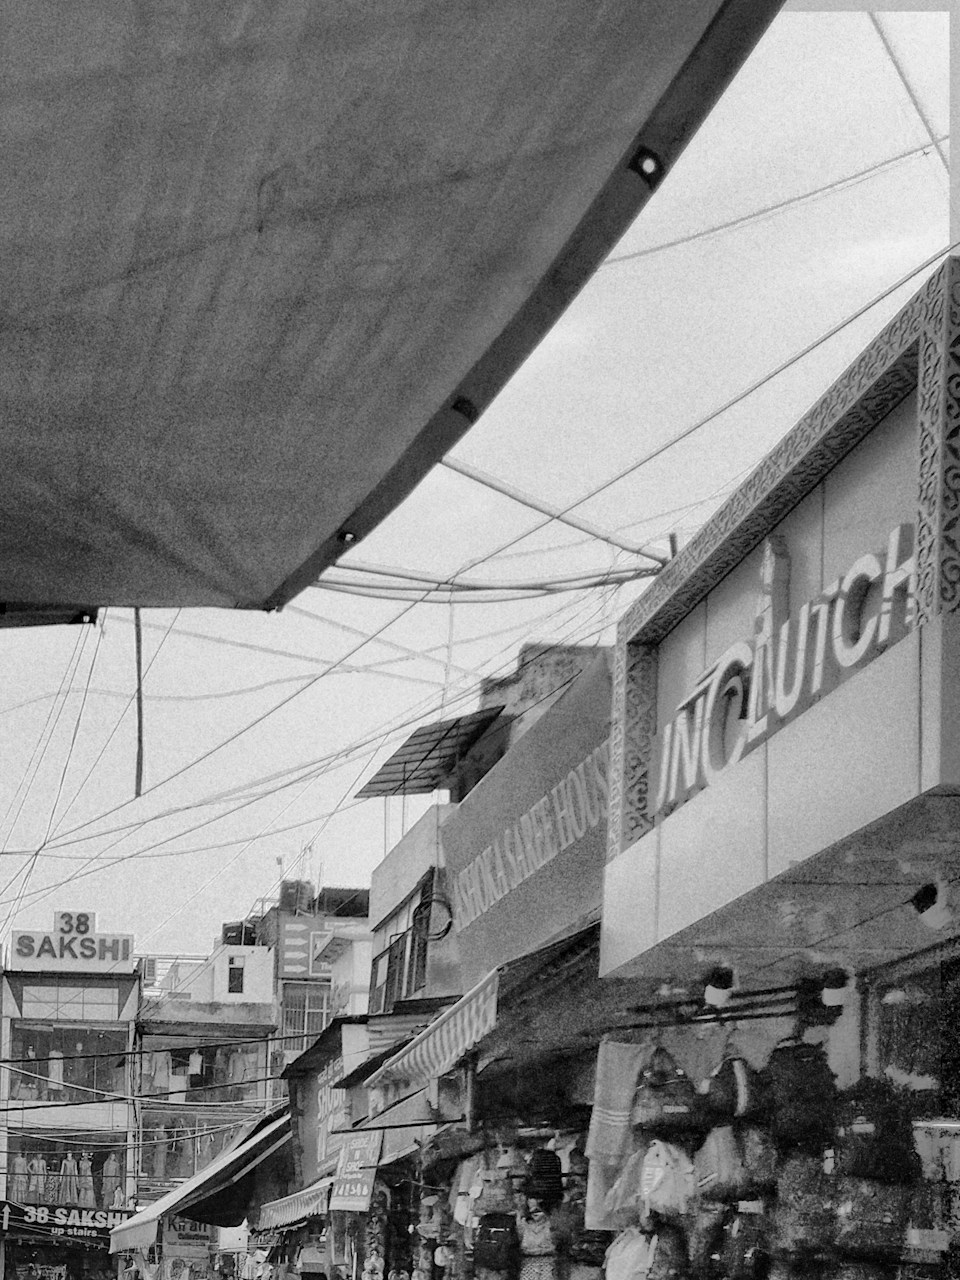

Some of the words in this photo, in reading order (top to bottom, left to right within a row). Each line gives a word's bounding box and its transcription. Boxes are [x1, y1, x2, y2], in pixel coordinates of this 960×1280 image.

[59, 912, 90, 935] 38
[16, 934, 130, 961] SAKSHI
[24, 1206, 49, 1224] 38
[54, 1207, 130, 1228] SAKSHI
[51, 1228, 64, 1236] up
[67, 1227, 98, 1237] stairs
